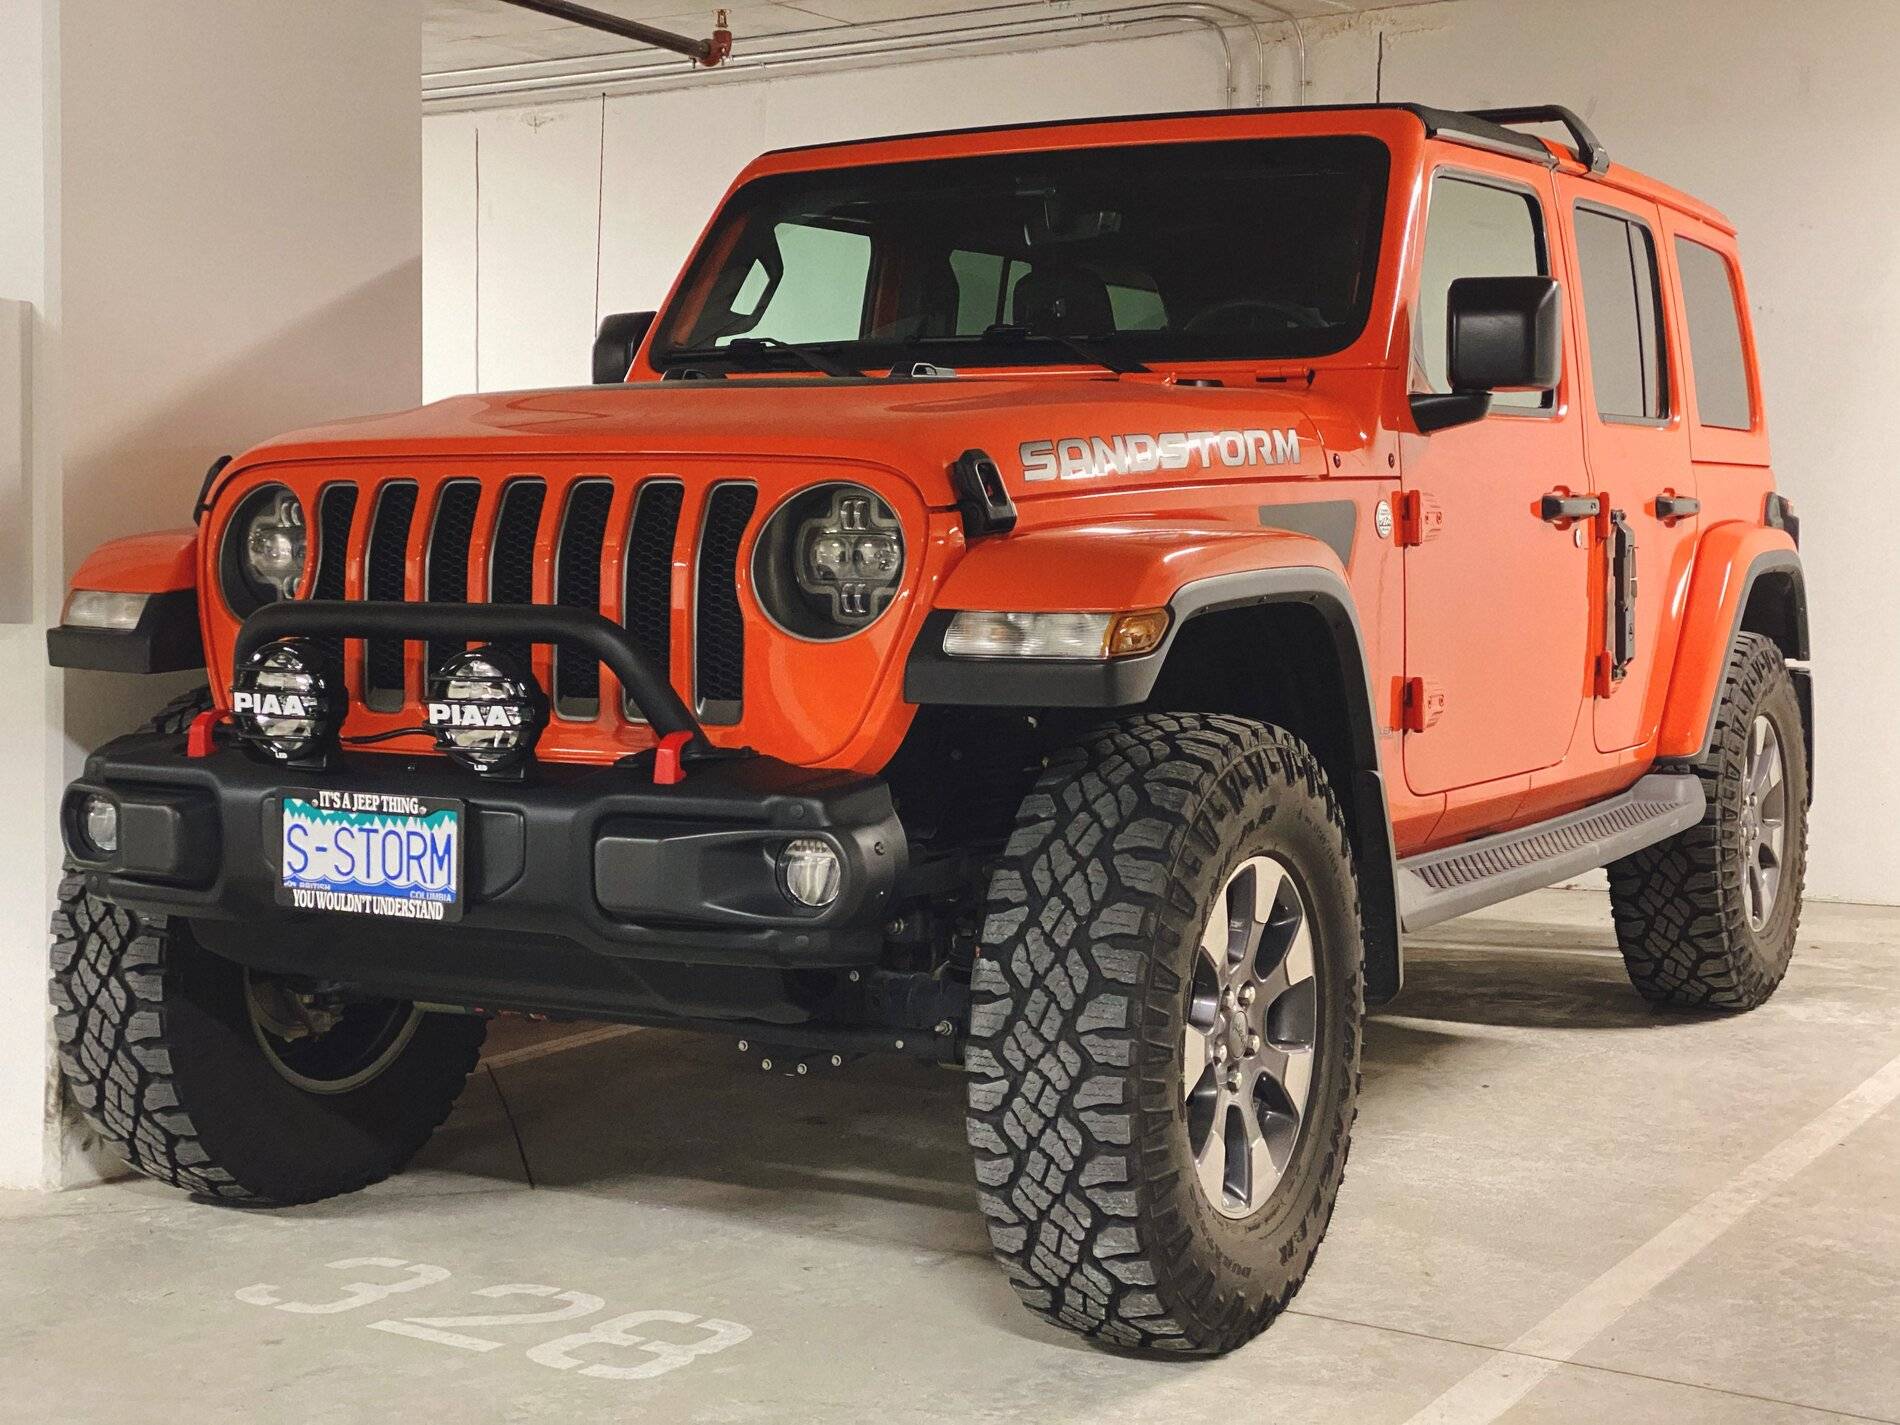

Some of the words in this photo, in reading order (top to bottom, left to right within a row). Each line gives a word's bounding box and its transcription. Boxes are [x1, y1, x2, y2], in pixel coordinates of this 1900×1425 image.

[1019, 428, 1301, 482] SANDSTORM
[234, 692, 306, 716] PIAA
[429, 703, 511, 727] PIAA
[319, 791, 341, 809] IT'S
[342, 792, 352, 809] A
[352, 793, 380, 812] JEEP
[381, 796, 419, 815] THING
[287, 823, 452, 885] S-STORM
[293, 889, 316, 908] YOU
[316, 890, 371, 914] WOULDN'T
[373, 897, 445, 921] UNDERSTAND
[410, 890, 452, 902] COLUMBIA
[235, 1257, 752, 1380] 328
